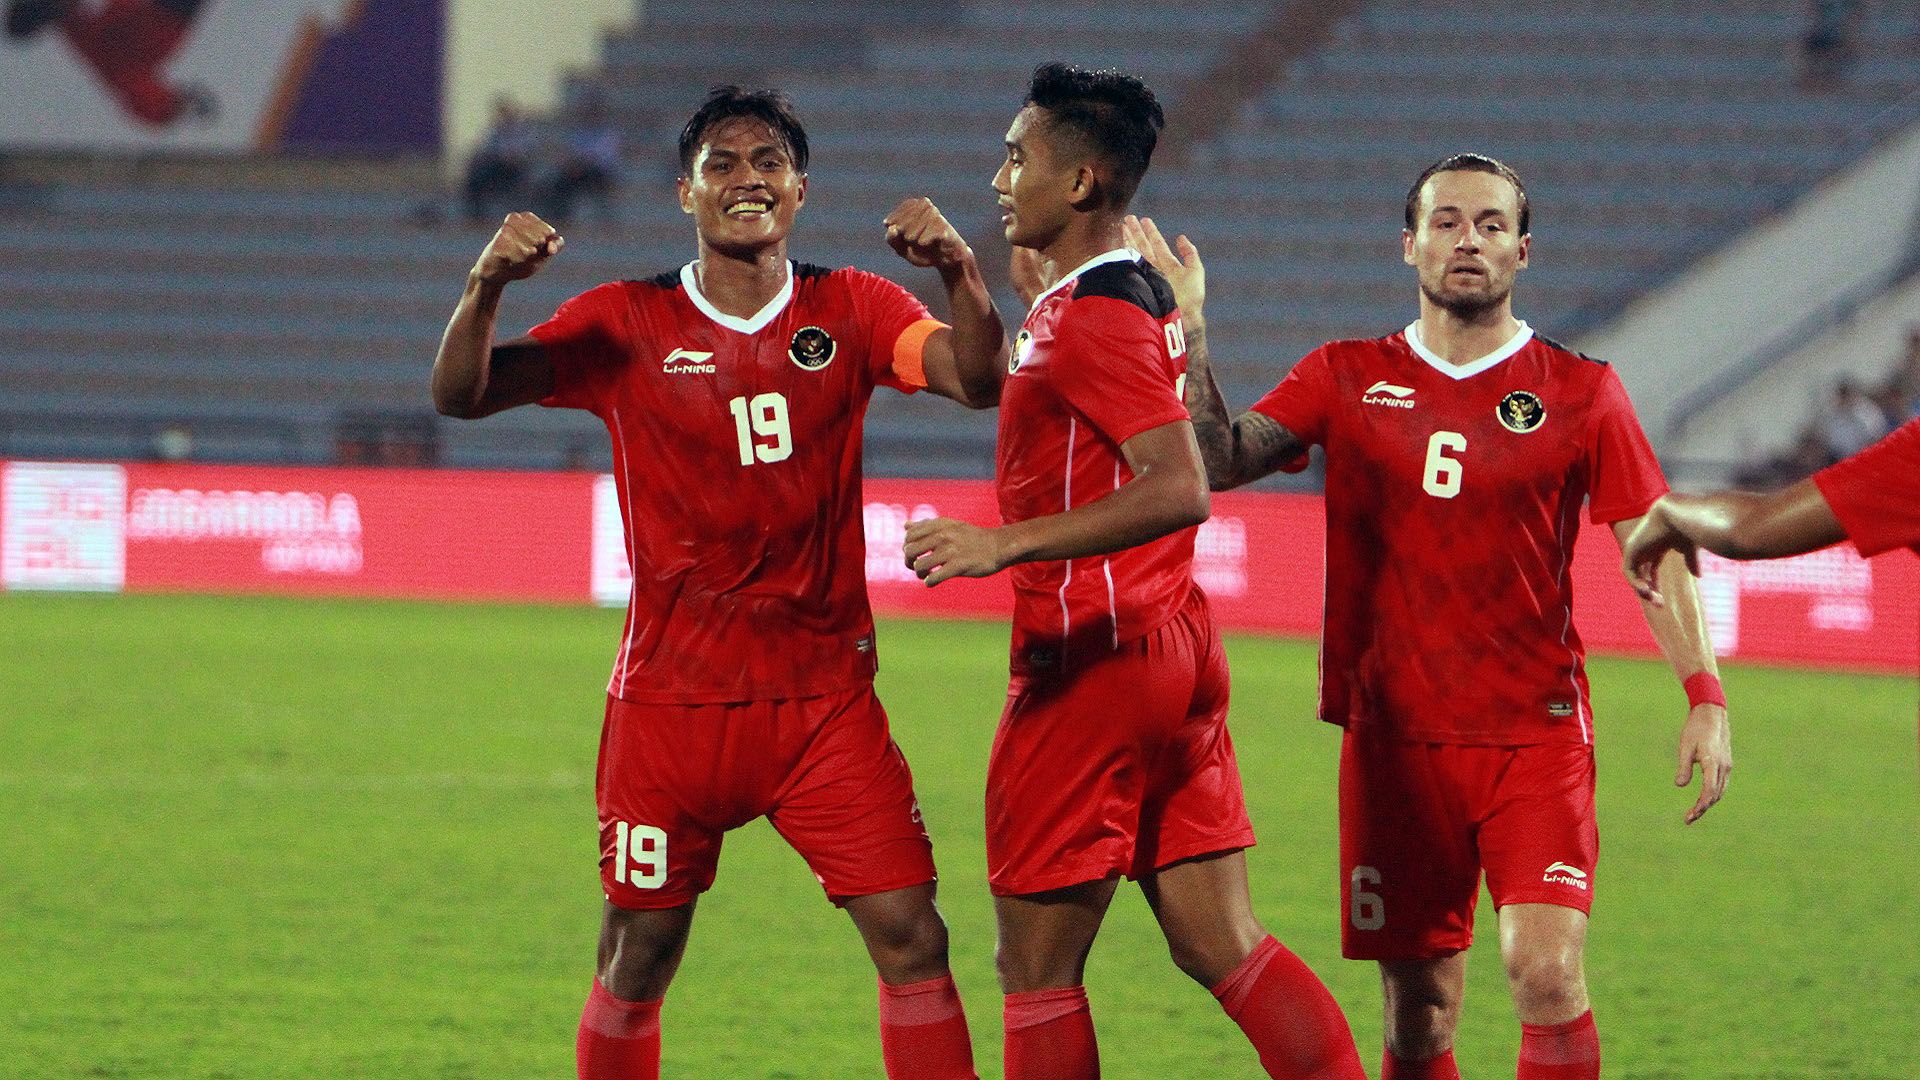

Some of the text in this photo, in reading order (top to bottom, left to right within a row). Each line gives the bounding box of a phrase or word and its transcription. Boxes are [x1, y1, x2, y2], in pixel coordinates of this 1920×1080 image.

[663, 364, 716, 374] LI-NING
[1362, 394, 1415, 409] LI-NING
[729, 391, 794, 467] 19
[1422, 430, 1468, 499] 6
[615, 821, 667, 889] 19
[1543, 873, 1588, 891] LI-NING
[1351, 865, 1385, 931] 6
